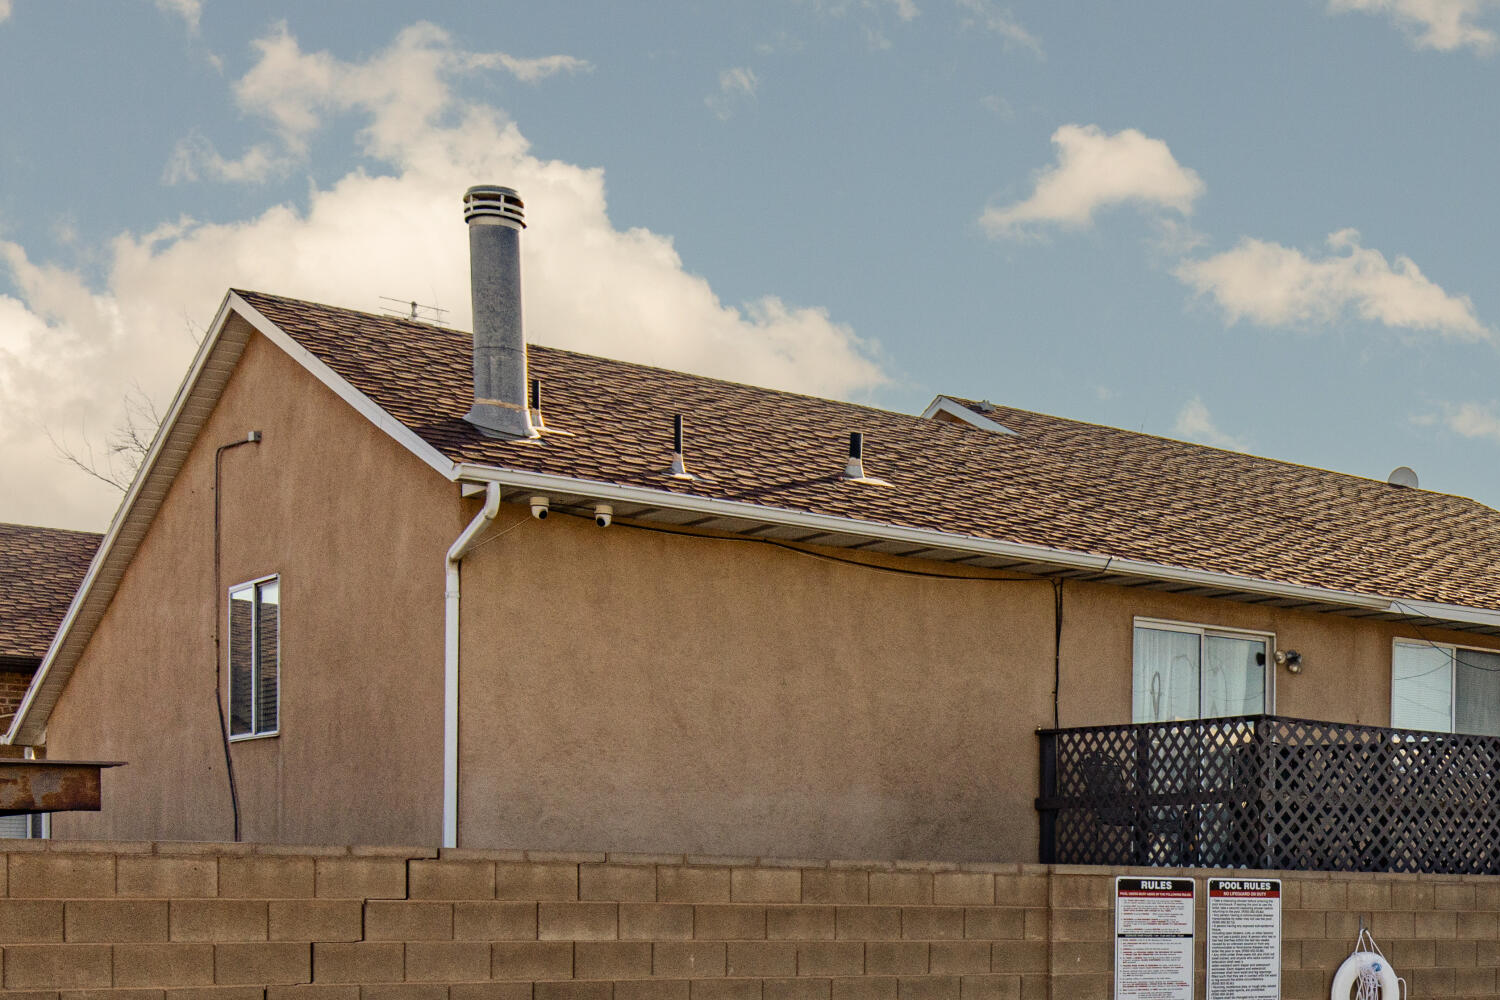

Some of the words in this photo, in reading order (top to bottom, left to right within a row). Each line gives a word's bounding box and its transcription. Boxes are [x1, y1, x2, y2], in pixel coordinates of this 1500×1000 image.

[1141, 881, 1173, 890] RULES
[1219, 882, 1242, 890] POOL
[1244, 882, 1271, 890] RULES
